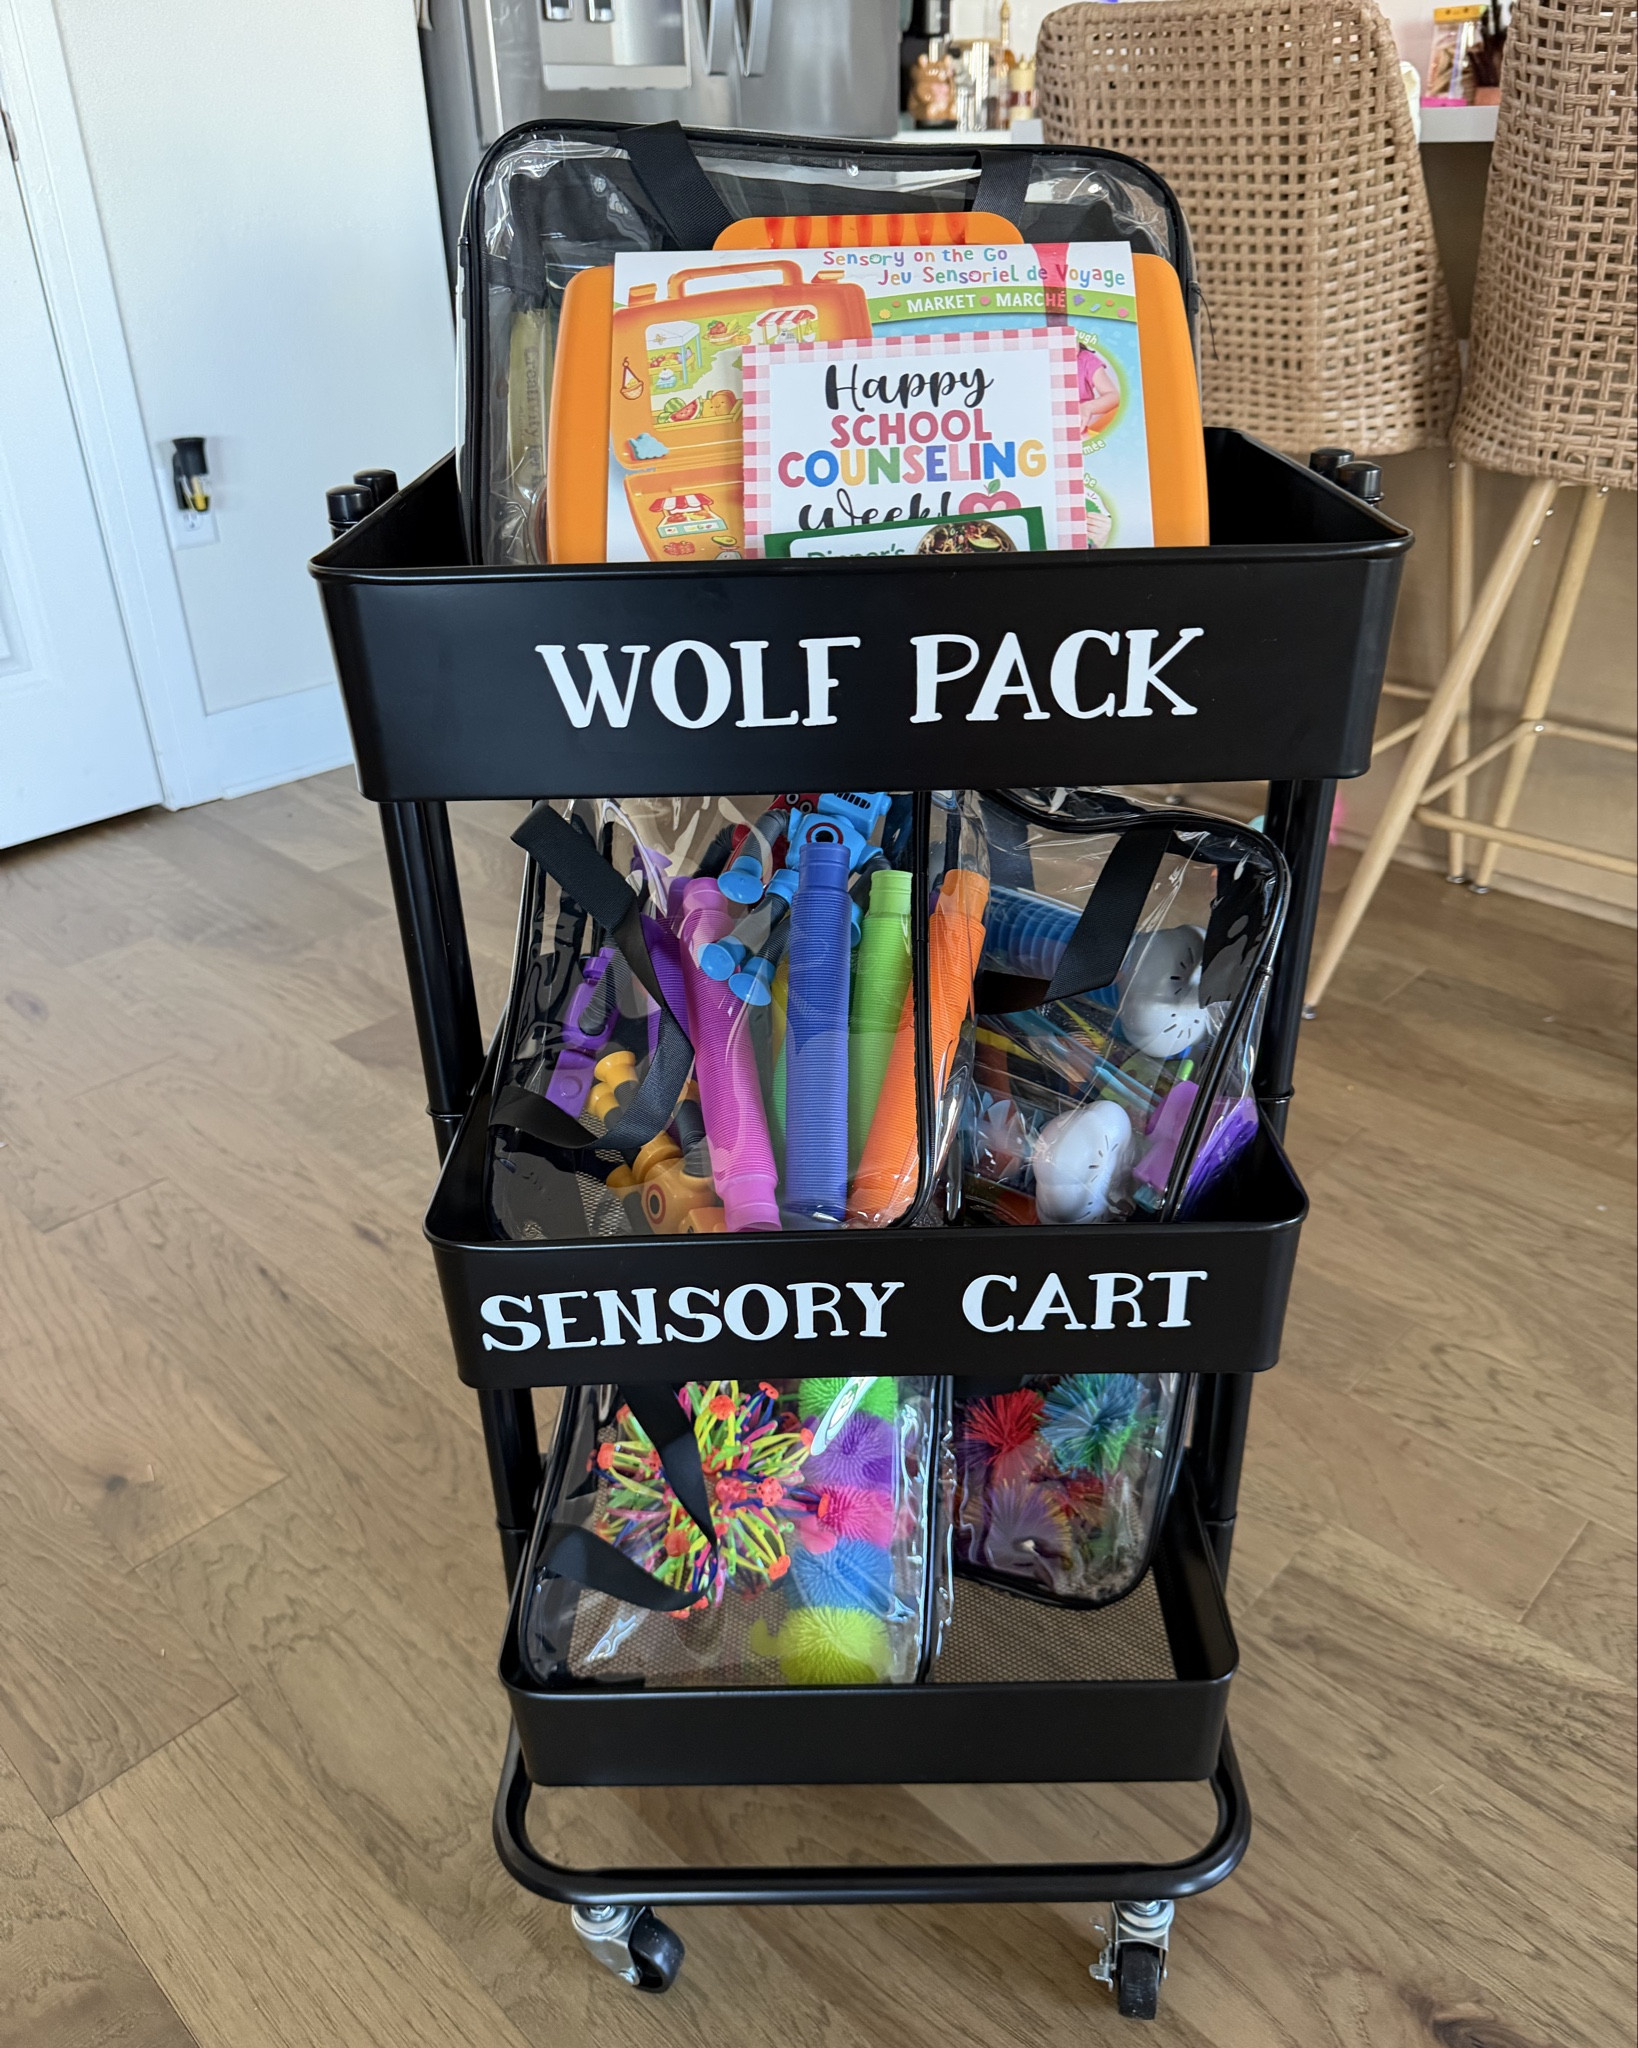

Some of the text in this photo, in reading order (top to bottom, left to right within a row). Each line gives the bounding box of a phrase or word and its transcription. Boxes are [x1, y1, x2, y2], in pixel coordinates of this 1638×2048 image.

[823, 247, 1008, 267] Sensory on the Go
[878, 264, 1126, 288] Jeu Sensoriel de Voyage
[907, 290, 1066, 313] MARKET MARCHÉ
[825, 363, 995, 413] Happy
[830, 408, 993, 449] SCHOOL
[778, 439, 1047, 488] COUNSELING
[534, 627, 1205, 730] WOLF PACK
[480, 1270, 1208, 1352] SENSORY CART
